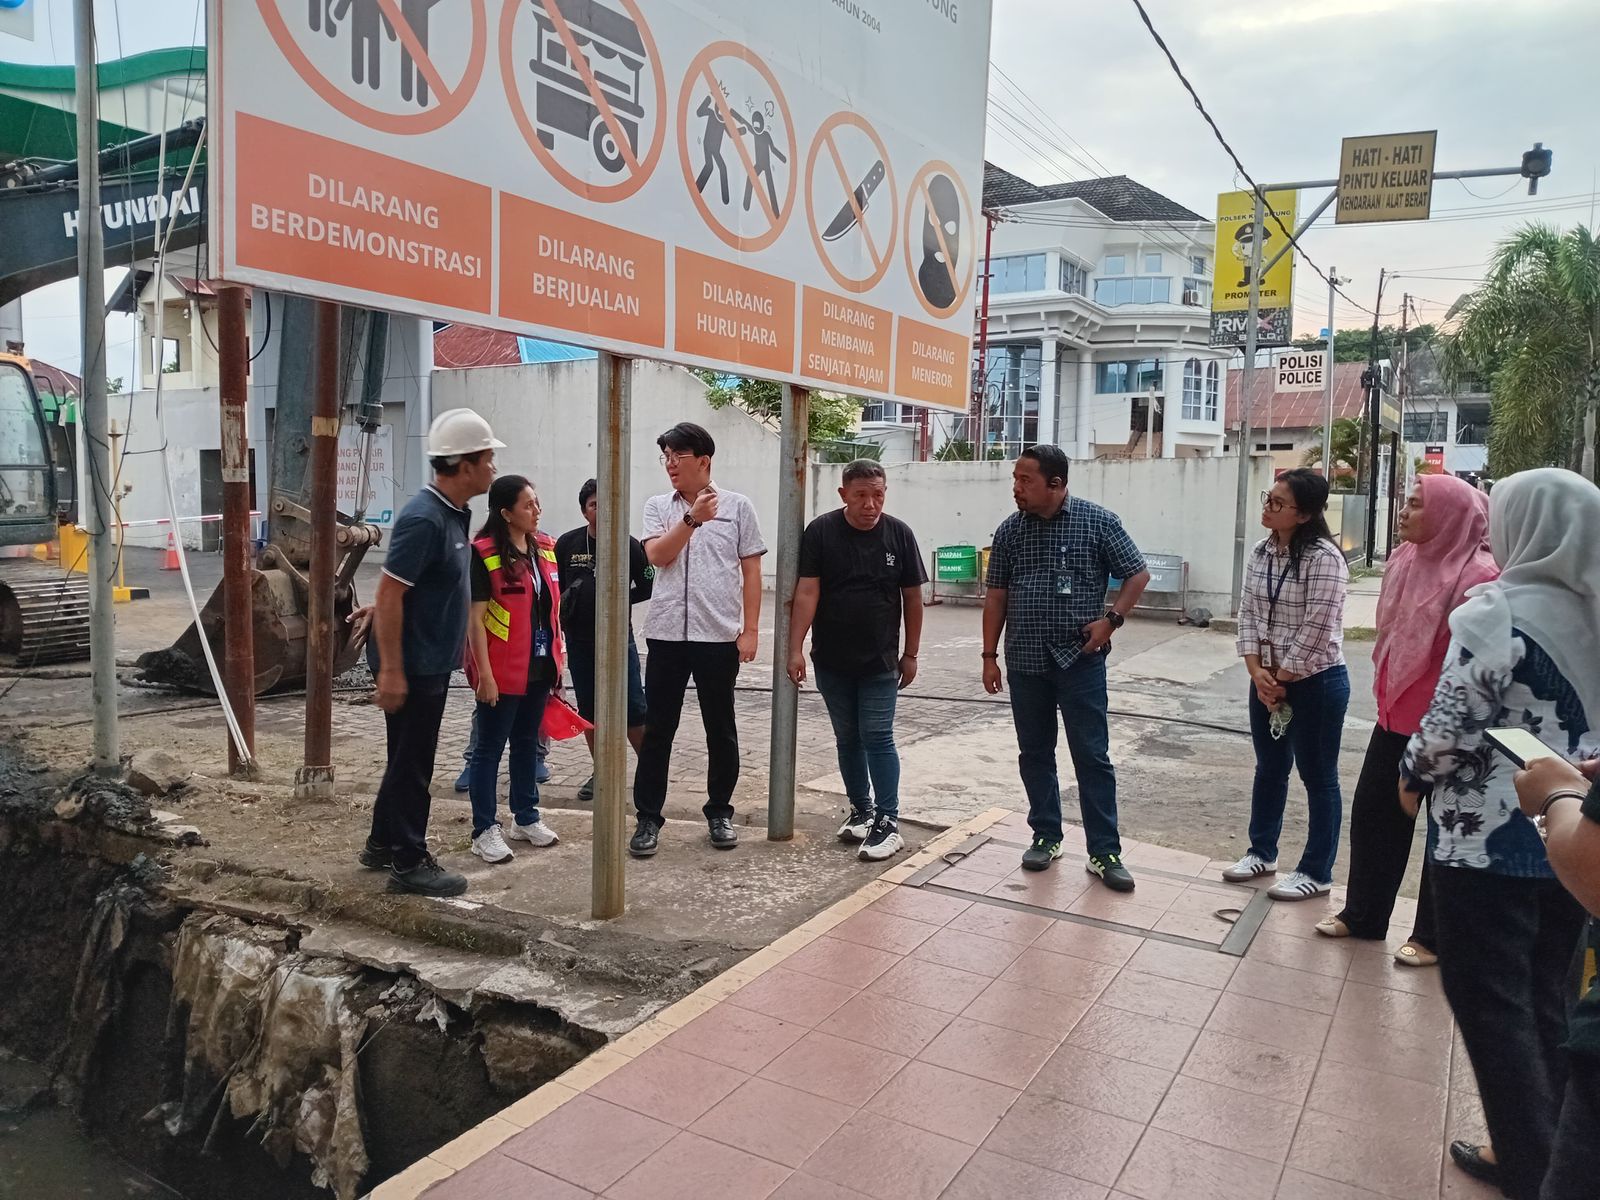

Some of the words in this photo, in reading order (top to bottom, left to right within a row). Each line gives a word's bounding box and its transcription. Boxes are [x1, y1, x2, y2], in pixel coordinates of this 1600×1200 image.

[832, 0, 860, 20] AHUN
[862, 10, 880, 34] 2004
[1352, 148, 1382, 167] HATI
[1392, 145, 1422, 165] HATI
[1343, 172, 1378, 190] PINTU
[1380, 170, 1428, 188] KELUAR
[63, 186, 200, 238] HUNDAI
[308, 173, 439, 228] DILARANG
[1340, 195, 1382, 211] KENDARAAN
[1386, 193, 1404, 208] ALAT
[1404, 192, 1428, 208] BERAT
[251, 203, 481, 278] BERDEMONSTRASI
[538, 234, 634, 280] DILARANG
[533, 272, 640, 316] BERJUALAN
[703, 281, 772, 316] DILARANG
[1224, 290, 1277, 299] PROMTER
[697, 312, 736, 338] HURU
[741, 323, 778, 348] HARA
[823, 301, 874, 330] DILARANG
[821, 329, 874, 356] MEMBAWA
[912, 341, 954, 365] DILARANG
[808, 354, 851, 376] SENJATA
[854, 364, 884, 384] TAJAM
[1280, 355, 1322, 369] POLISI
[912, 366, 952, 388] MENEROR
[1279, 371, 1322, 385] POLICE
